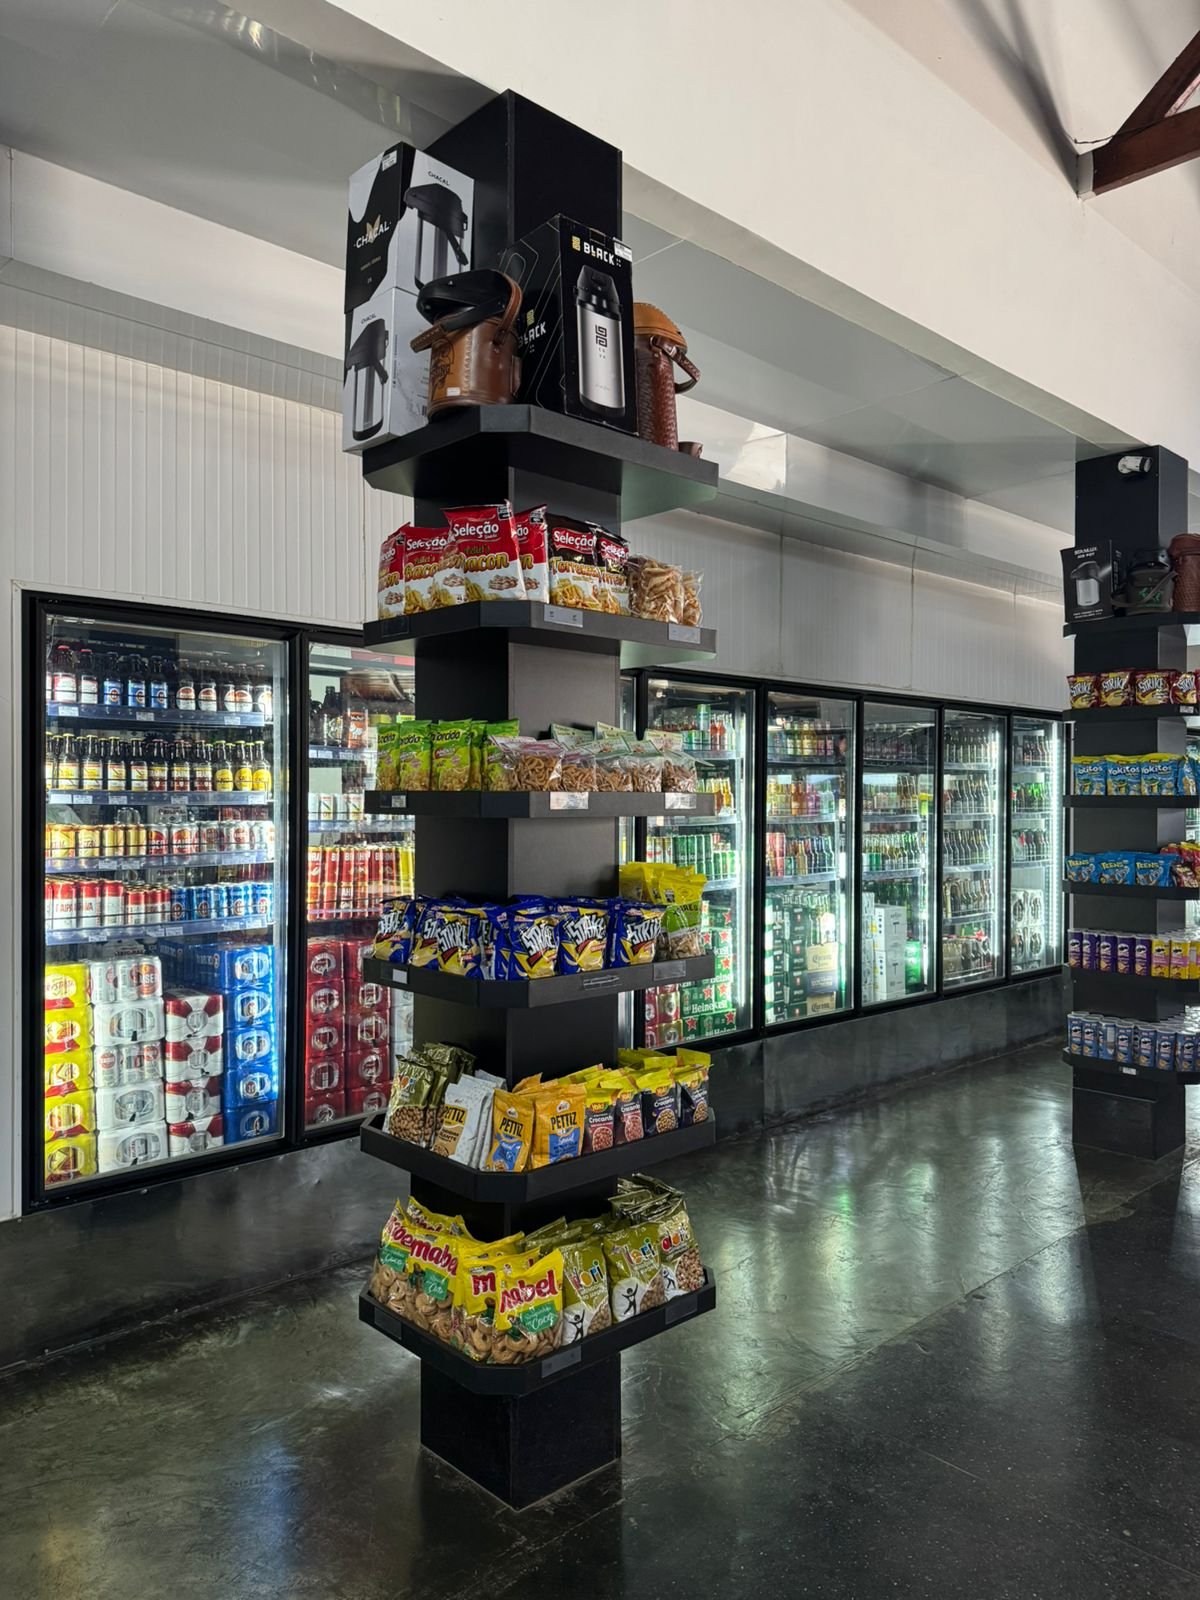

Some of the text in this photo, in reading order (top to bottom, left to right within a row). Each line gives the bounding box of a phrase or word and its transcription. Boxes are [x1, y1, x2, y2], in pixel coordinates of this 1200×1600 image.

[583, 241, 615, 266] BLACK
[452, 521, 500, 539] Seleção
[553, 530, 598, 550] Seleção
[499, 1117, 523, 1138] PETTIZ
[550, 1111, 577, 1131] PETTIZ
